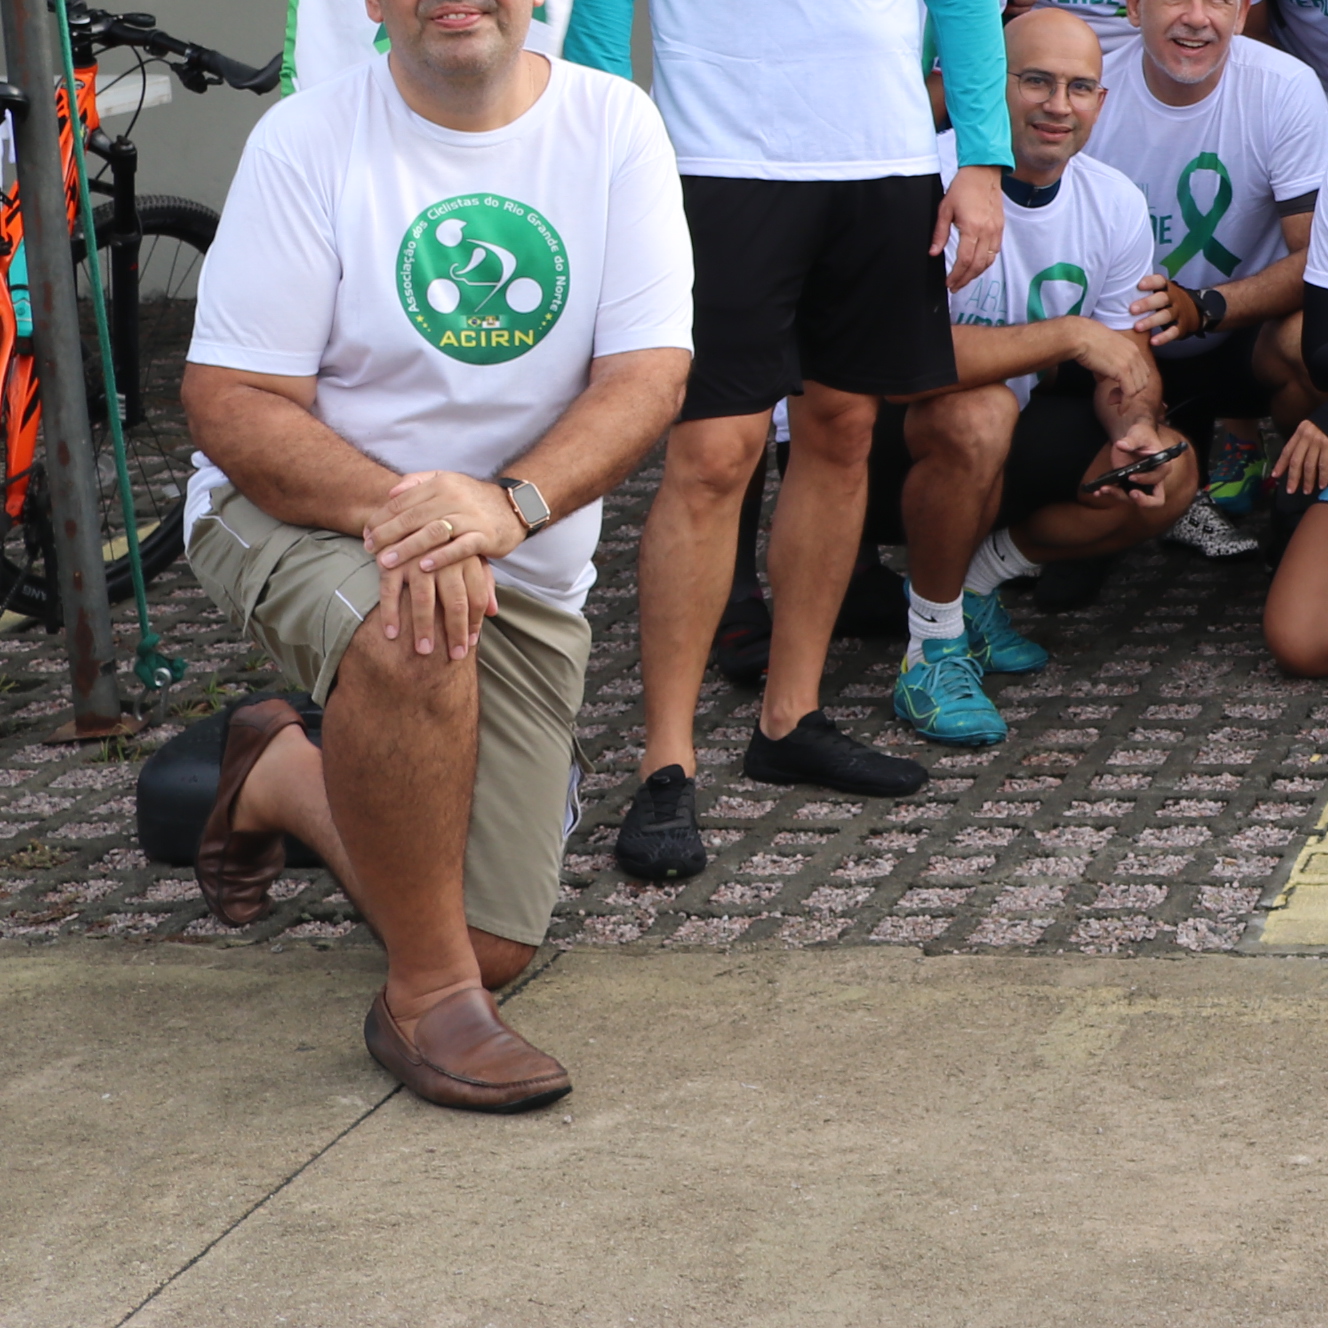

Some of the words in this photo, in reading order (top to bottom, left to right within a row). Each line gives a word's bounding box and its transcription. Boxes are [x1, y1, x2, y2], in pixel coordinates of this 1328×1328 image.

[427, 197, 480, 221] Ciclistas
[484, 196, 500, 209] do
[503, 202, 525, 217] Rio
[412, 220, 428, 240] dos
[526, 212, 560, 253] Grande
[553, 255, 565, 272] do
[400, 240, 420, 313] Associação
[549, 275, 567, 313] Norte
[439, 329, 535, 348] ACIRN
